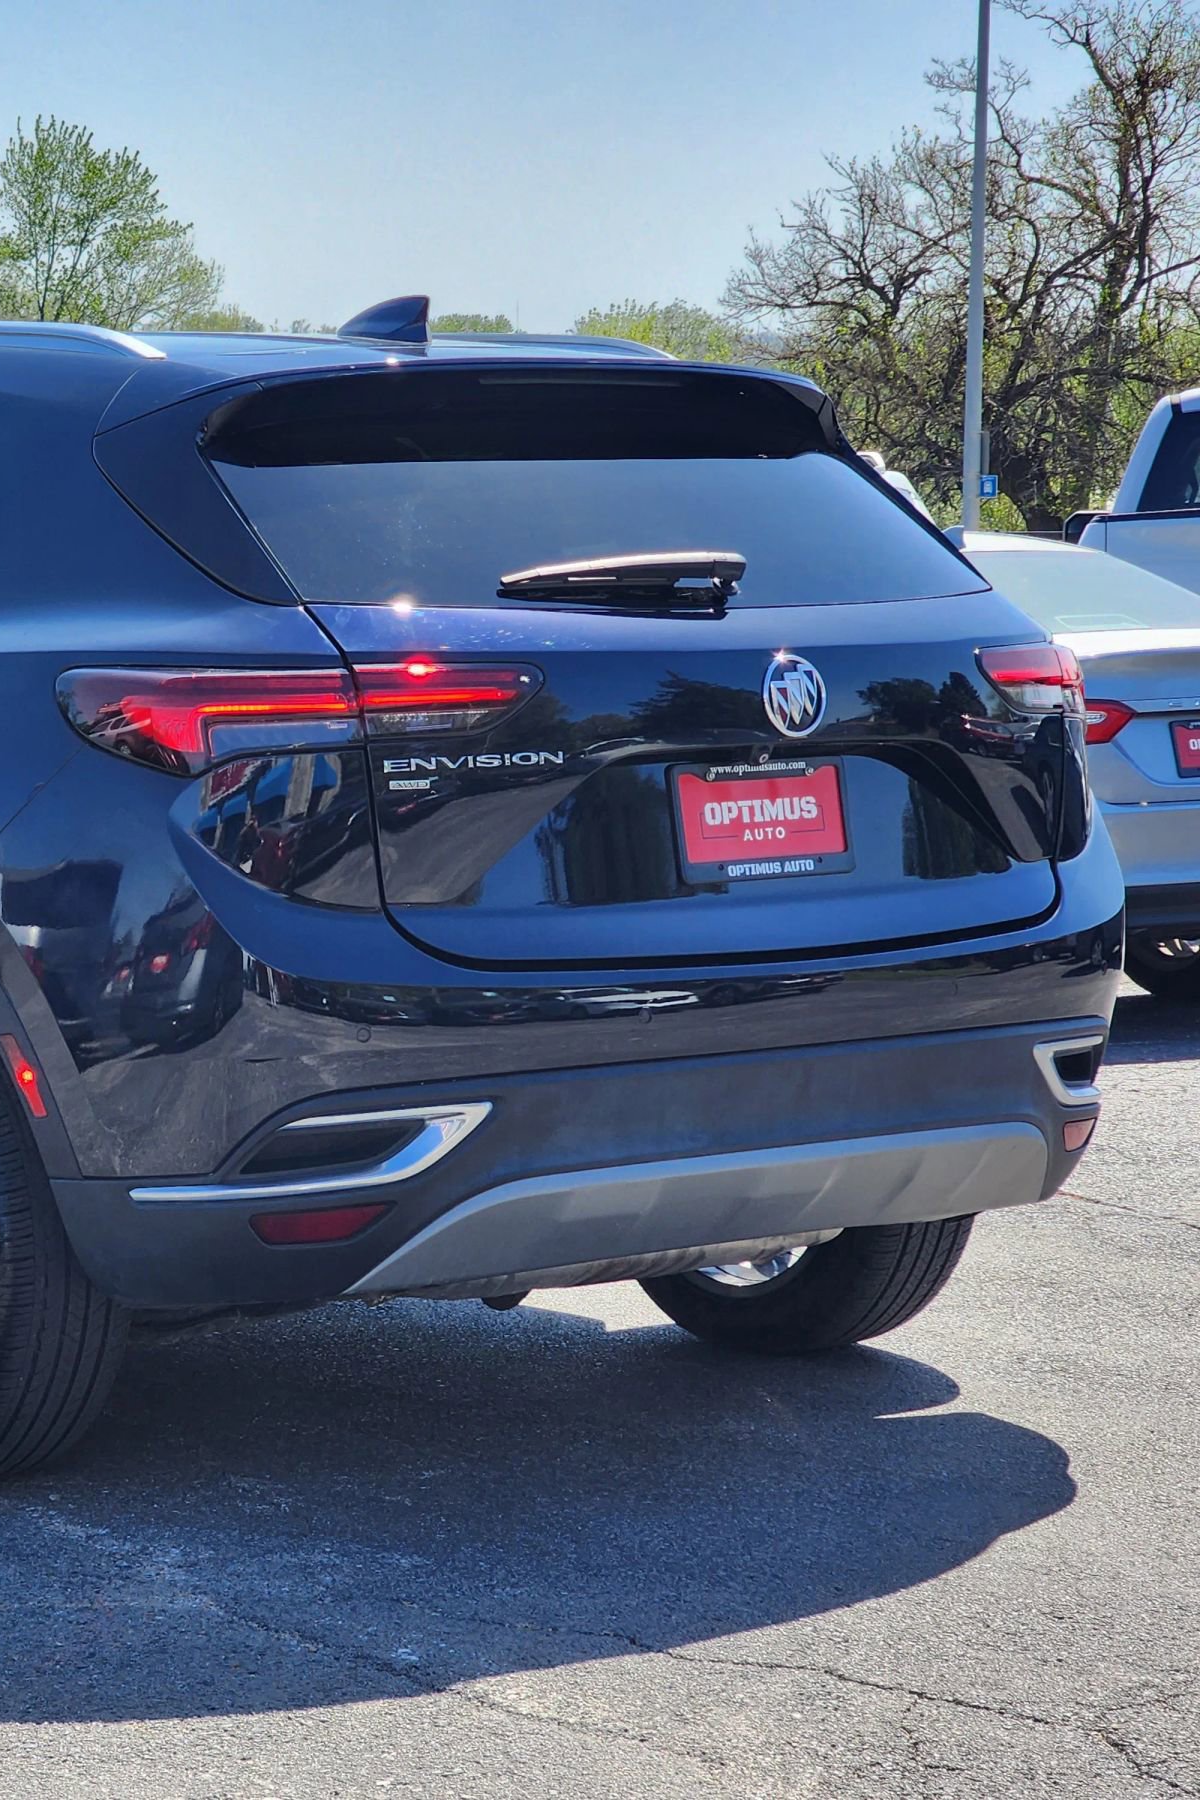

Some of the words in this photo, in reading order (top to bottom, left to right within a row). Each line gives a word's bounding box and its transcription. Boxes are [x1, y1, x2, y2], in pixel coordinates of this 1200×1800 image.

[383, 751, 563, 773] ENVISION
[390, 780, 430, 789] AWD
[704, 796, 818, 825] OPTIMUS
[743, 826, 786, 841] AUTO
[728, 861, 781, 877] OPTIMUS
[784, 859, 814, 874] AUTO
